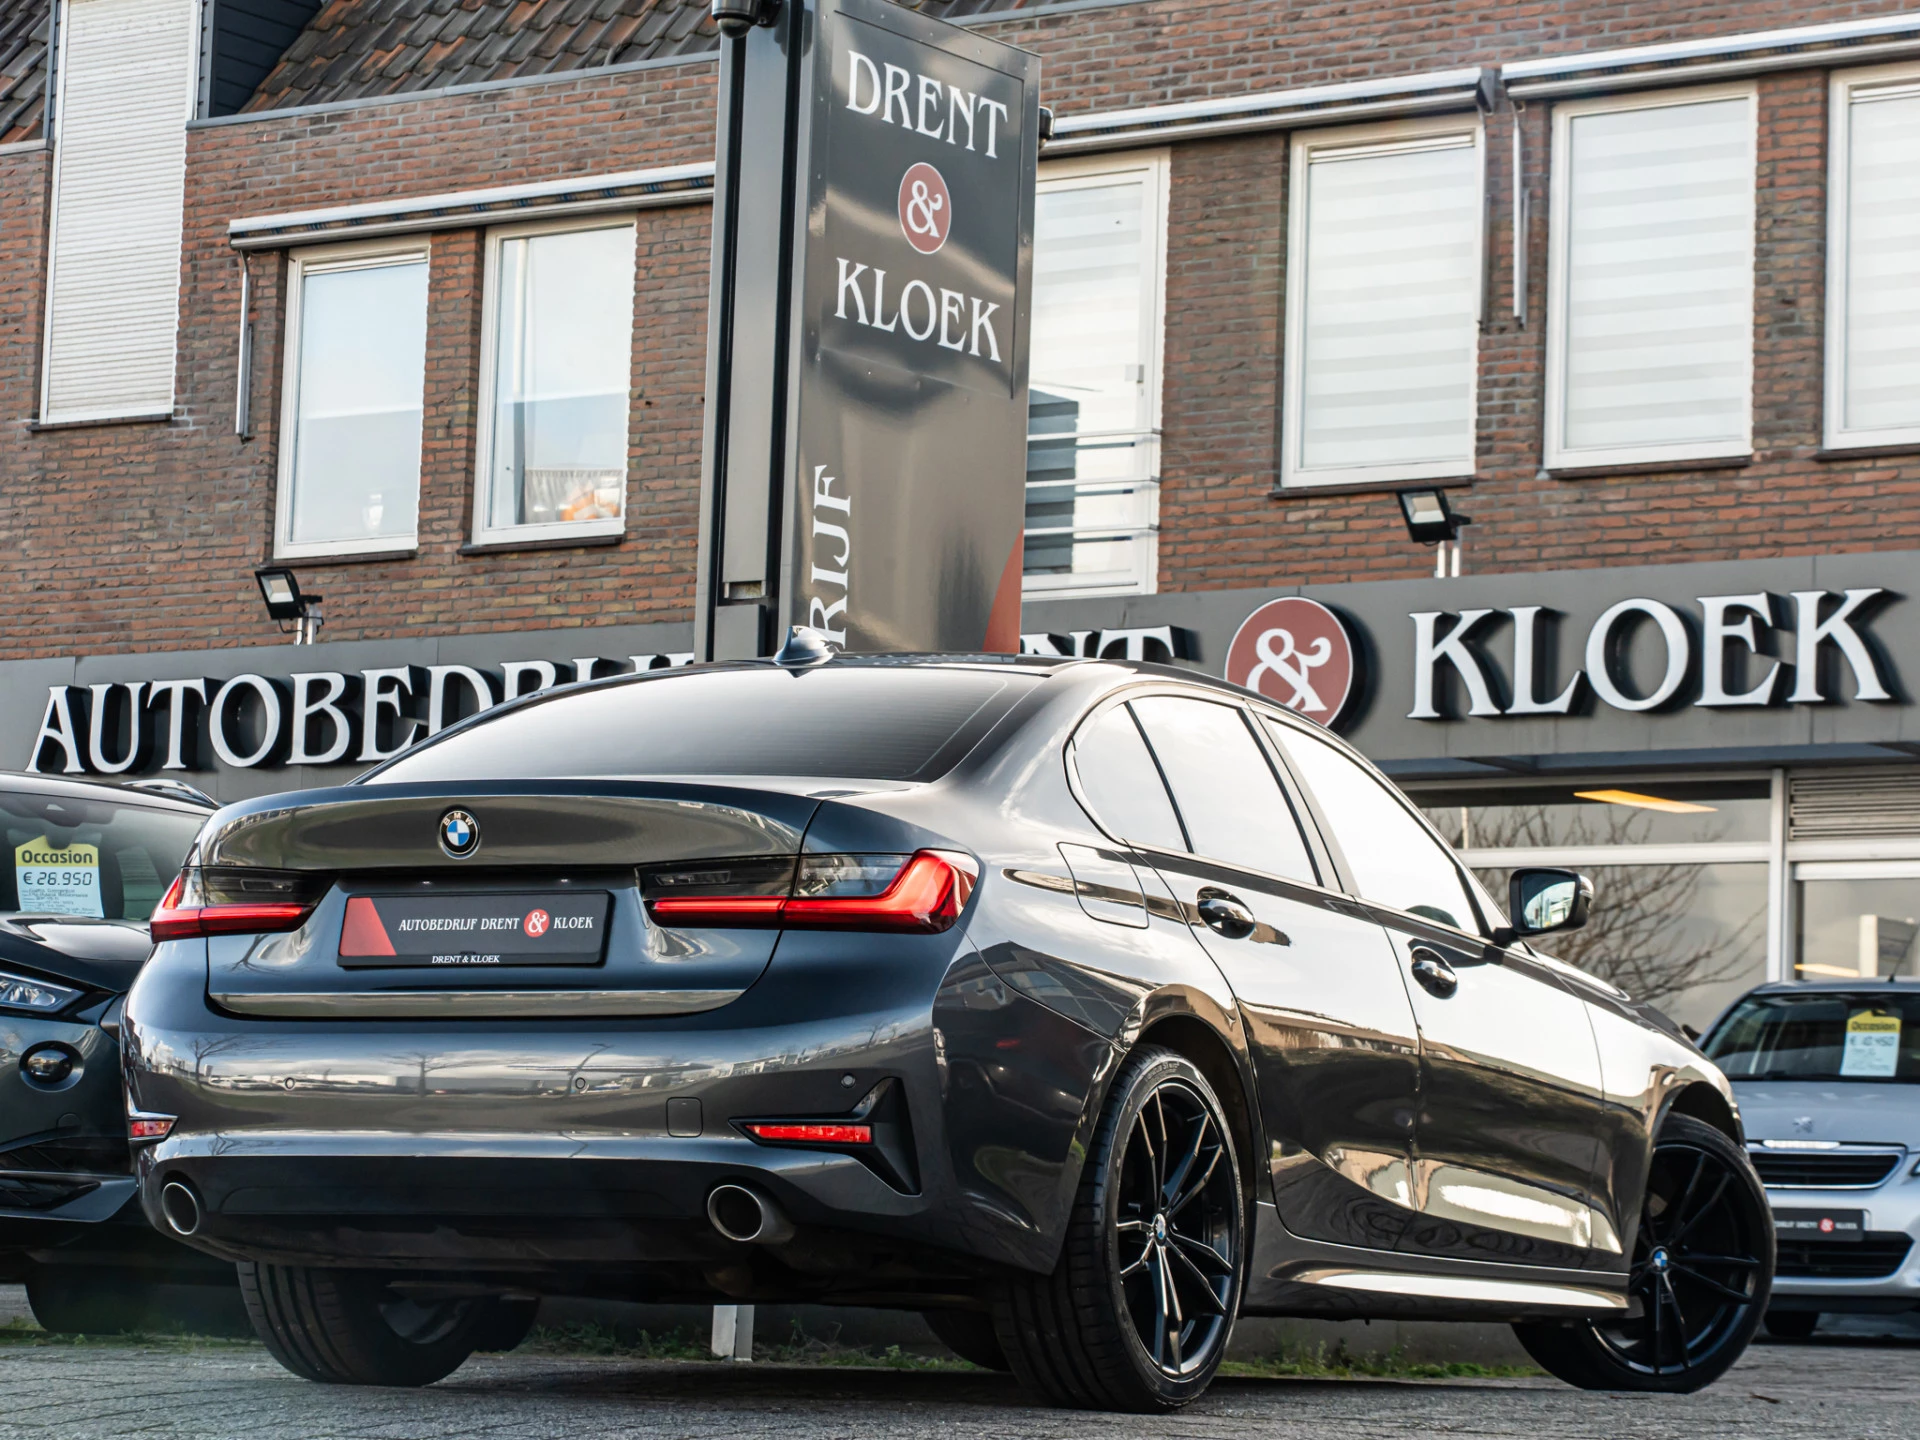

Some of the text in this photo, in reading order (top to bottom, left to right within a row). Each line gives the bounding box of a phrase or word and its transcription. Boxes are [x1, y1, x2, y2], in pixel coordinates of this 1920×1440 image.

[845, 50, 1008, 159] DRENT
[906, 179, 943, 238] &
[834, 257, 1001, 362] KLOEK
[25, 589, 1892, 773] AUTOBED & KLOEK
[443, 812, 473, 826] BMW
[21, 849, 93, 864] Occasion
[398, 911, 594, 933] AUTOBEDRIJF DRENT & KLOEK
[431, 954, 500, 964] DRENT & KLOEK
